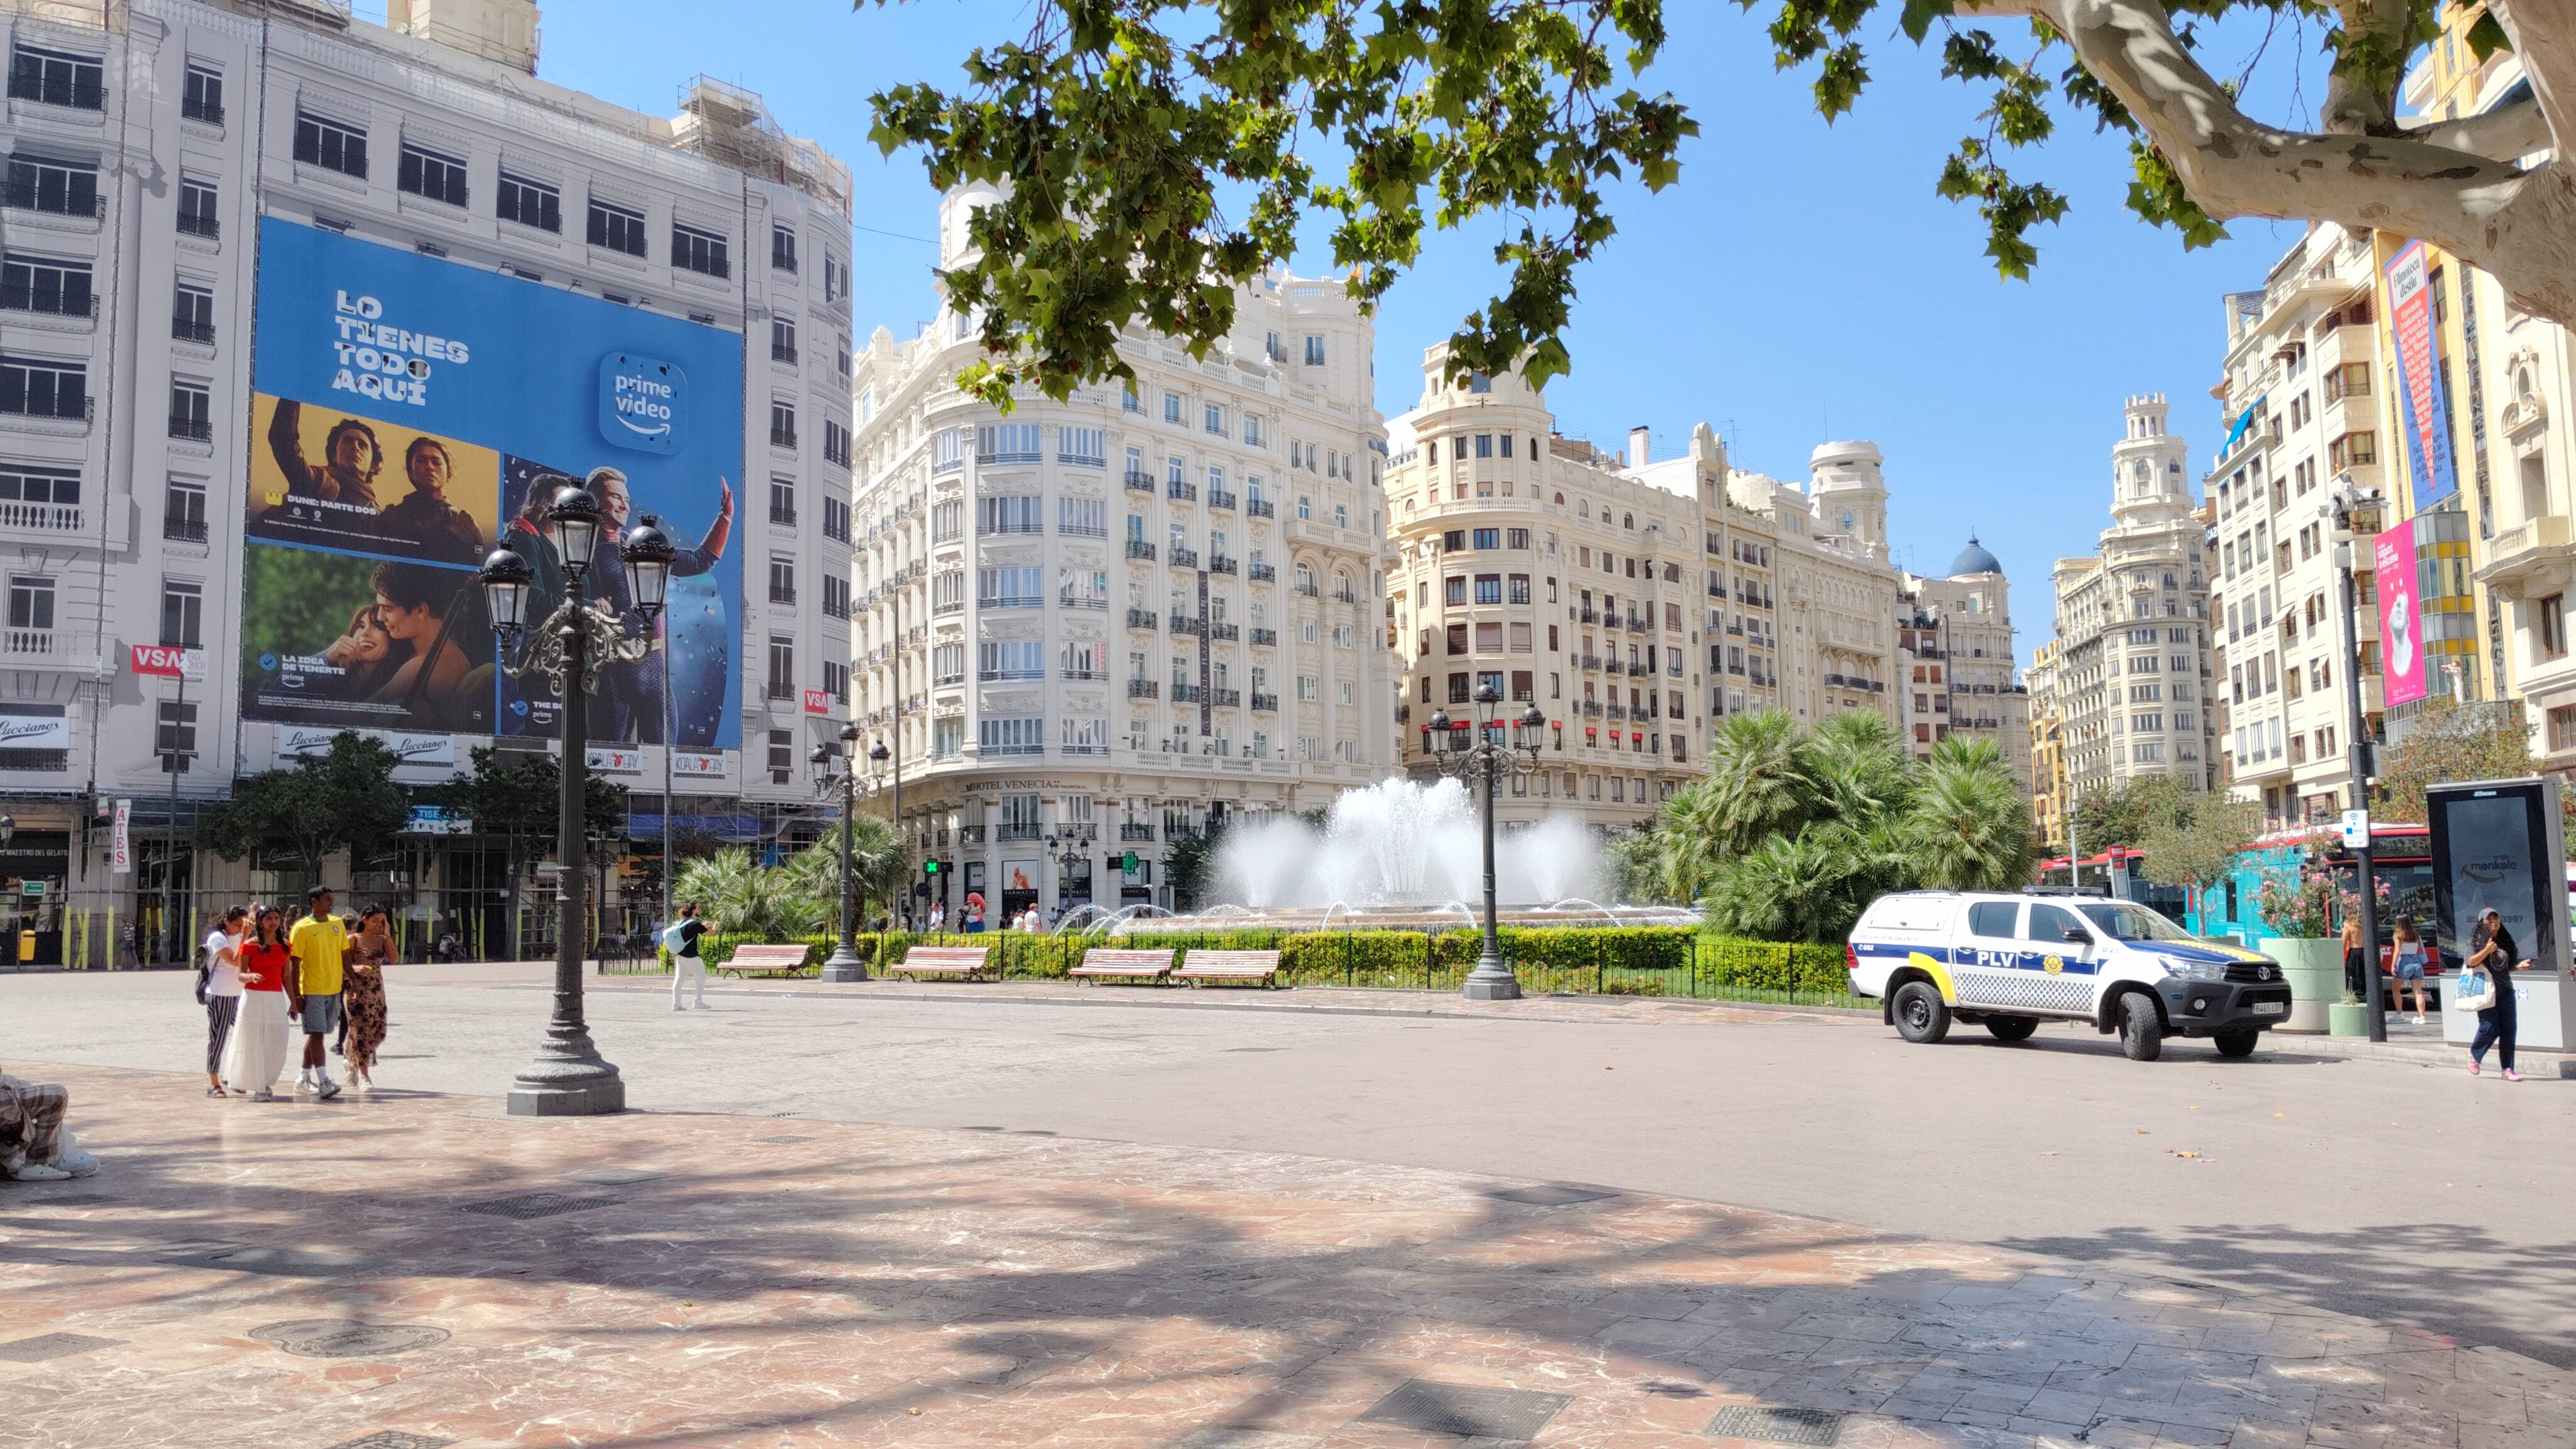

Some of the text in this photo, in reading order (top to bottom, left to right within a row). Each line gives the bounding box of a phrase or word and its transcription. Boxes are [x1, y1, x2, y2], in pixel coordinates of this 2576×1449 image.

[2394, 258, 2420, 288] Filmoteca
[337, 290, 382, 319] LO
[335, 315, 469, 364] TIENES
[334, 341, 431, 381] TODO
[332, 368, 426, 406] AQUÍ
[616, 374, 671, 398] prime
[615, 393, 671, 420] video
[288, 494, 377, 515] DUNE: PARTE DOS
[188, 652, 201, 660] GO
[282, 655, 325, 665] LA IDEA
[282, 663, 345, 675] DE TENERTE
[282, 674, 305, 683] prime
[0, 720, 59, 735] Lucciano's
[286, 732, 334, 746] Luccian
[397, 738, 447, 752] Lucciano's
[588, 752, 639, 768] KOALA BAY
[676, 757, 723, 772] KOALA BAY
[973, 781, 1003, 791] HOTEL
[1005, 780, 1053, 789] VENECIA
[1977, 951, 2014, 967] PLV
